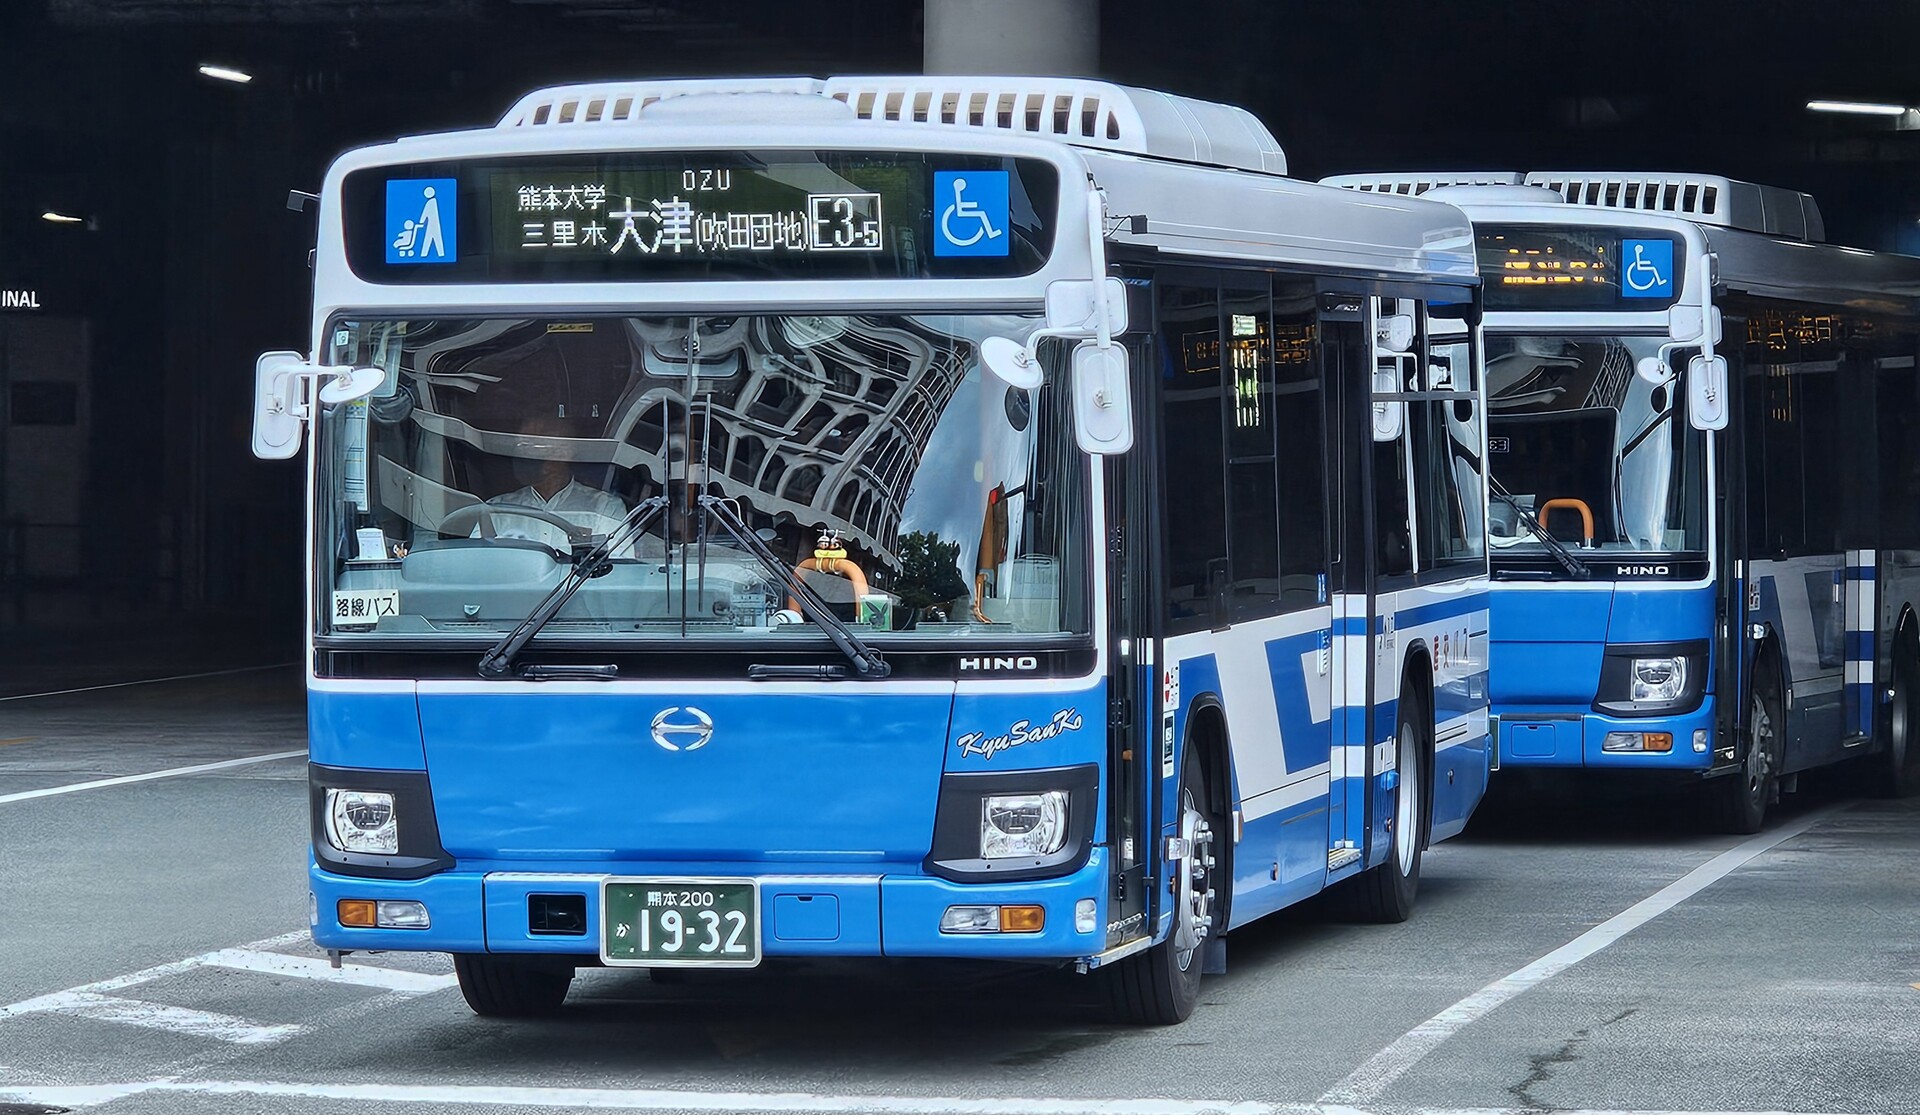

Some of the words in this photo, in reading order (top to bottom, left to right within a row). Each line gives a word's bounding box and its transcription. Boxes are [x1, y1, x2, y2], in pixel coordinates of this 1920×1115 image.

[683, 169, 731, 191] OZU
[517, 184, 606, 212] 熊本大学
[521, 220, 608, 248] 三里木
[812, 197, 879, 249] E3-5
[2, 290, 41, 308] INAL
[1617, 566, 1669, 575] HINO
[336, 597, 396, 617] 路線バス
[960, 656, 1038, 671] HINO
[641, 909, 746, 953] 19-32
